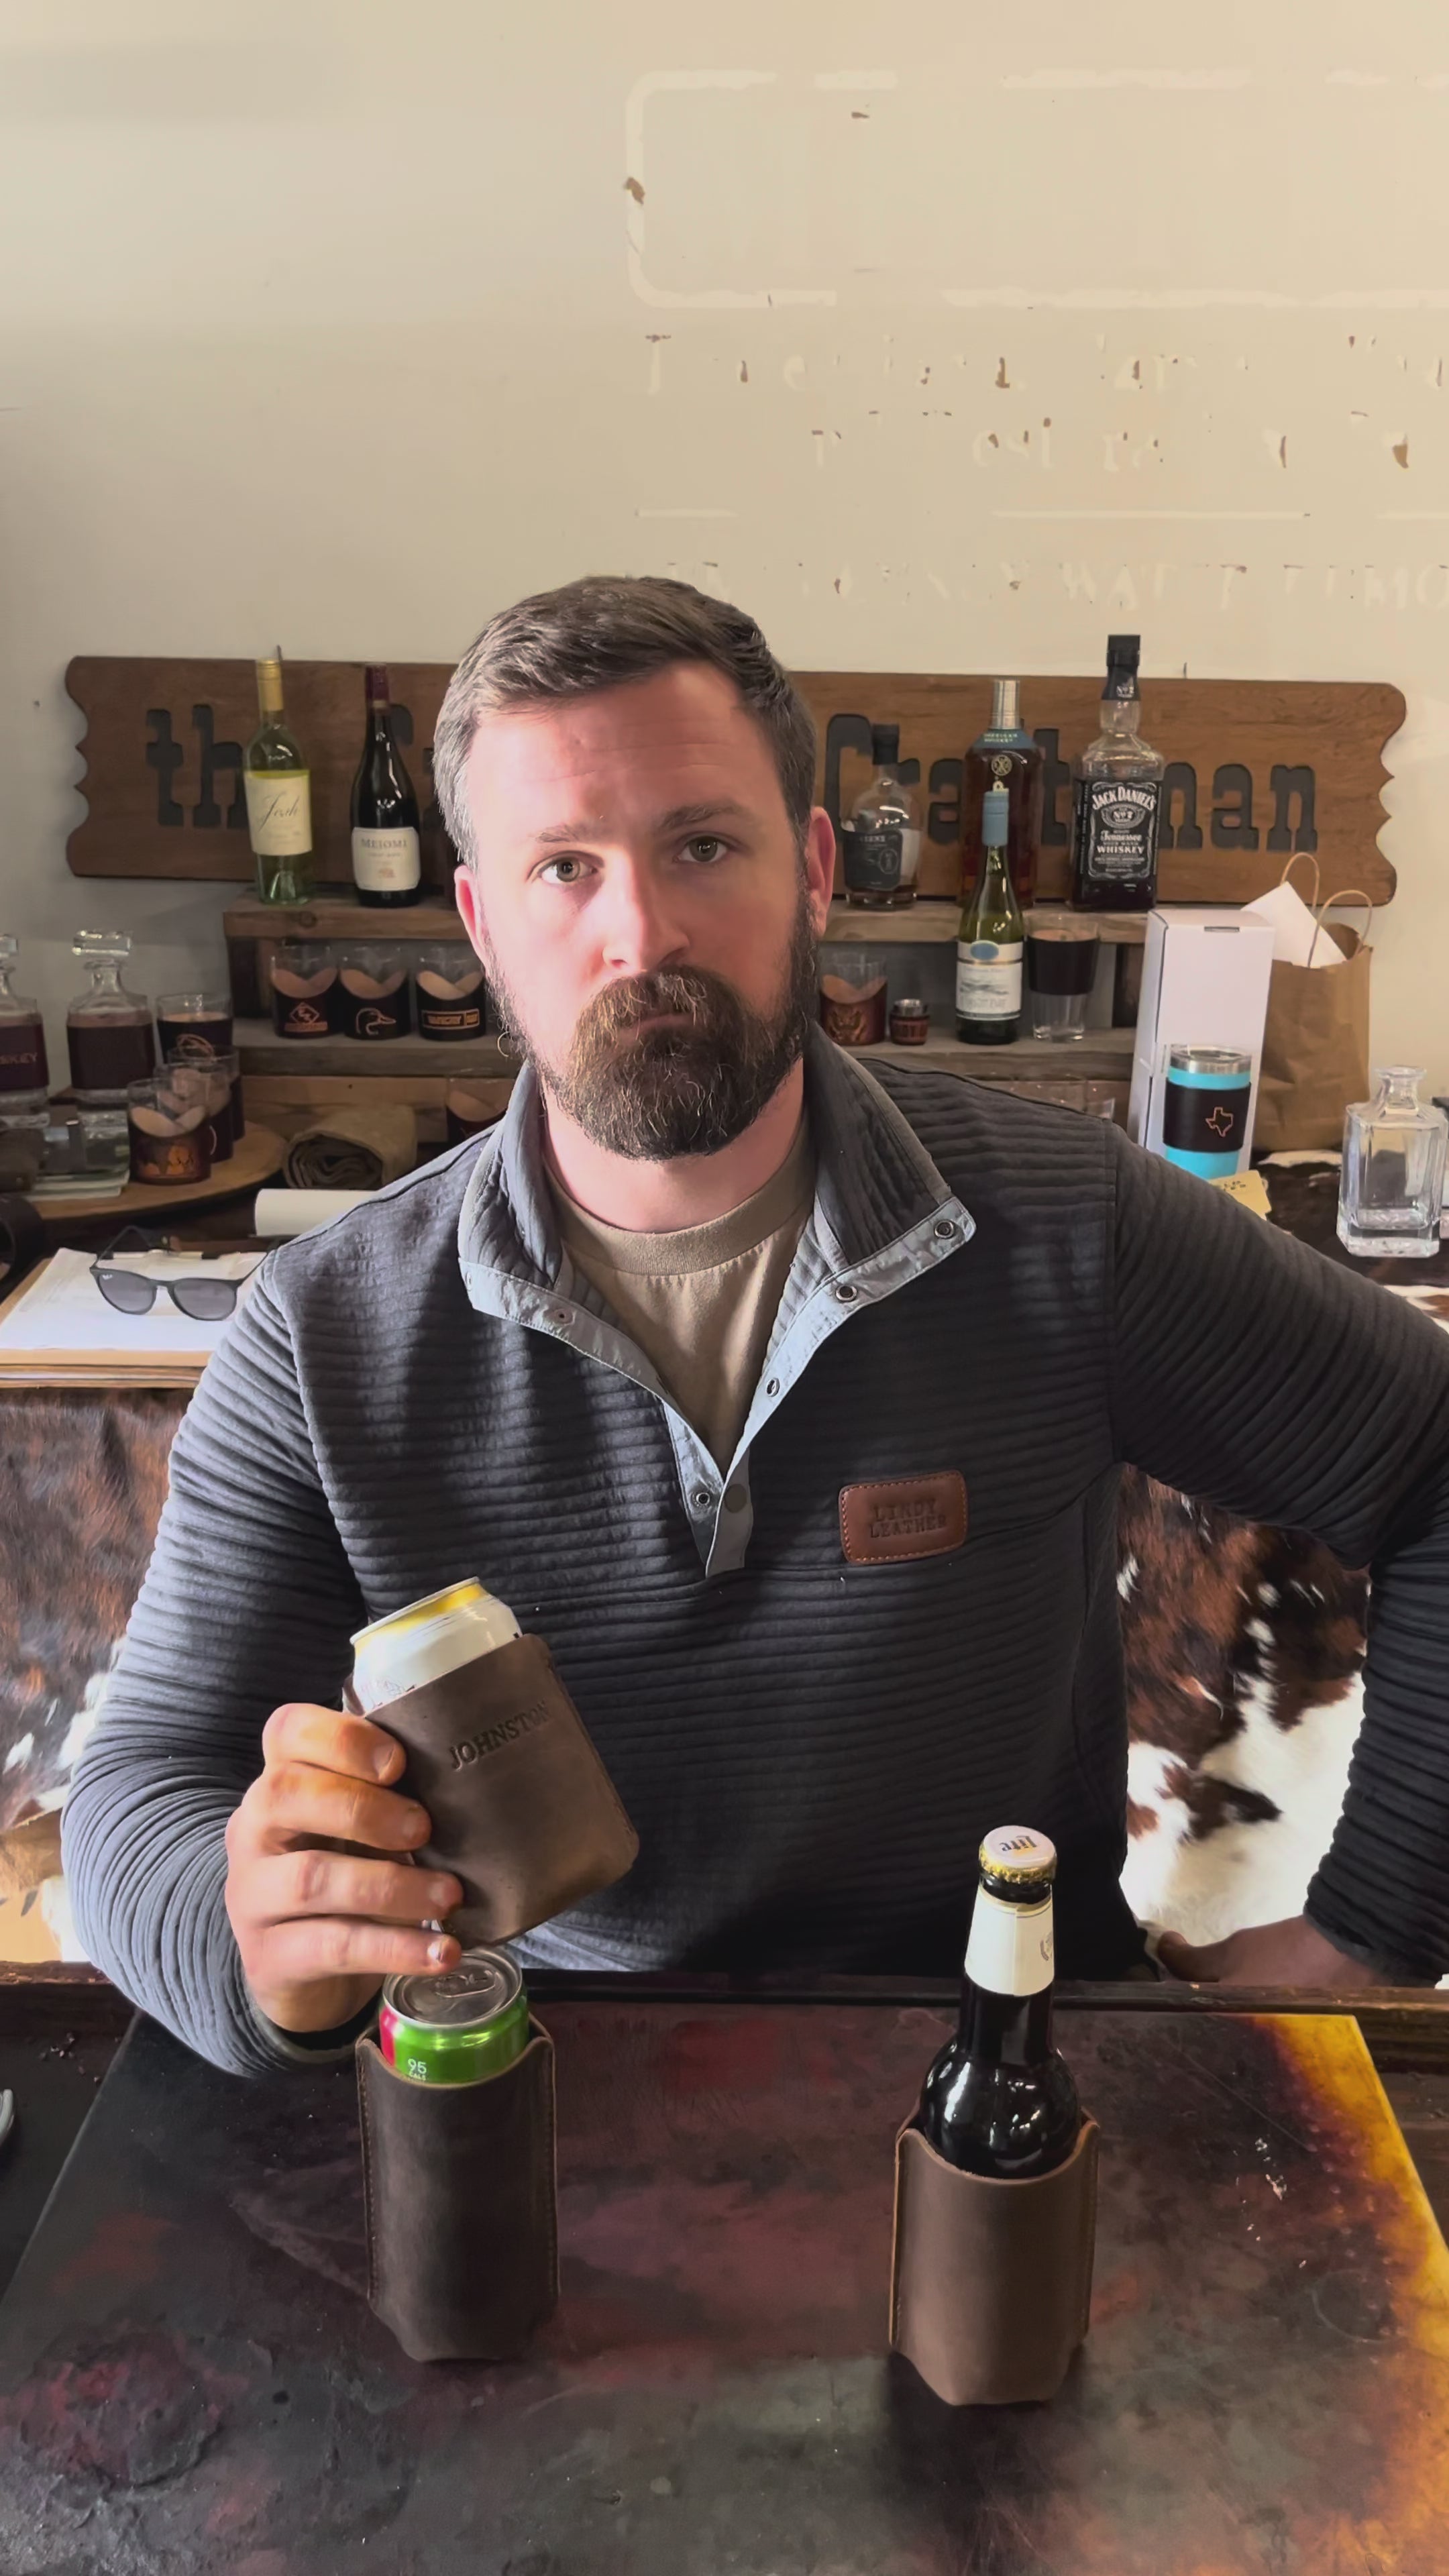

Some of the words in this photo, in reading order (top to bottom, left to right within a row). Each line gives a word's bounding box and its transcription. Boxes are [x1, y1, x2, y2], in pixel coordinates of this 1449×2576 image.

[146, 704, 250, 829] th
[824, 713, 1318, 852] Catman
[1092, 789, 1118, 810] JACK
[1117, 786, 1157, 812] DANIEL'S
[361, 838, 407, 849] MEIOMI
[1097, 845, 1144, 854] WHISKEY
[869, 1515, 947, 1538] LEATHER
[407, 2058, 427, 2074] 95
